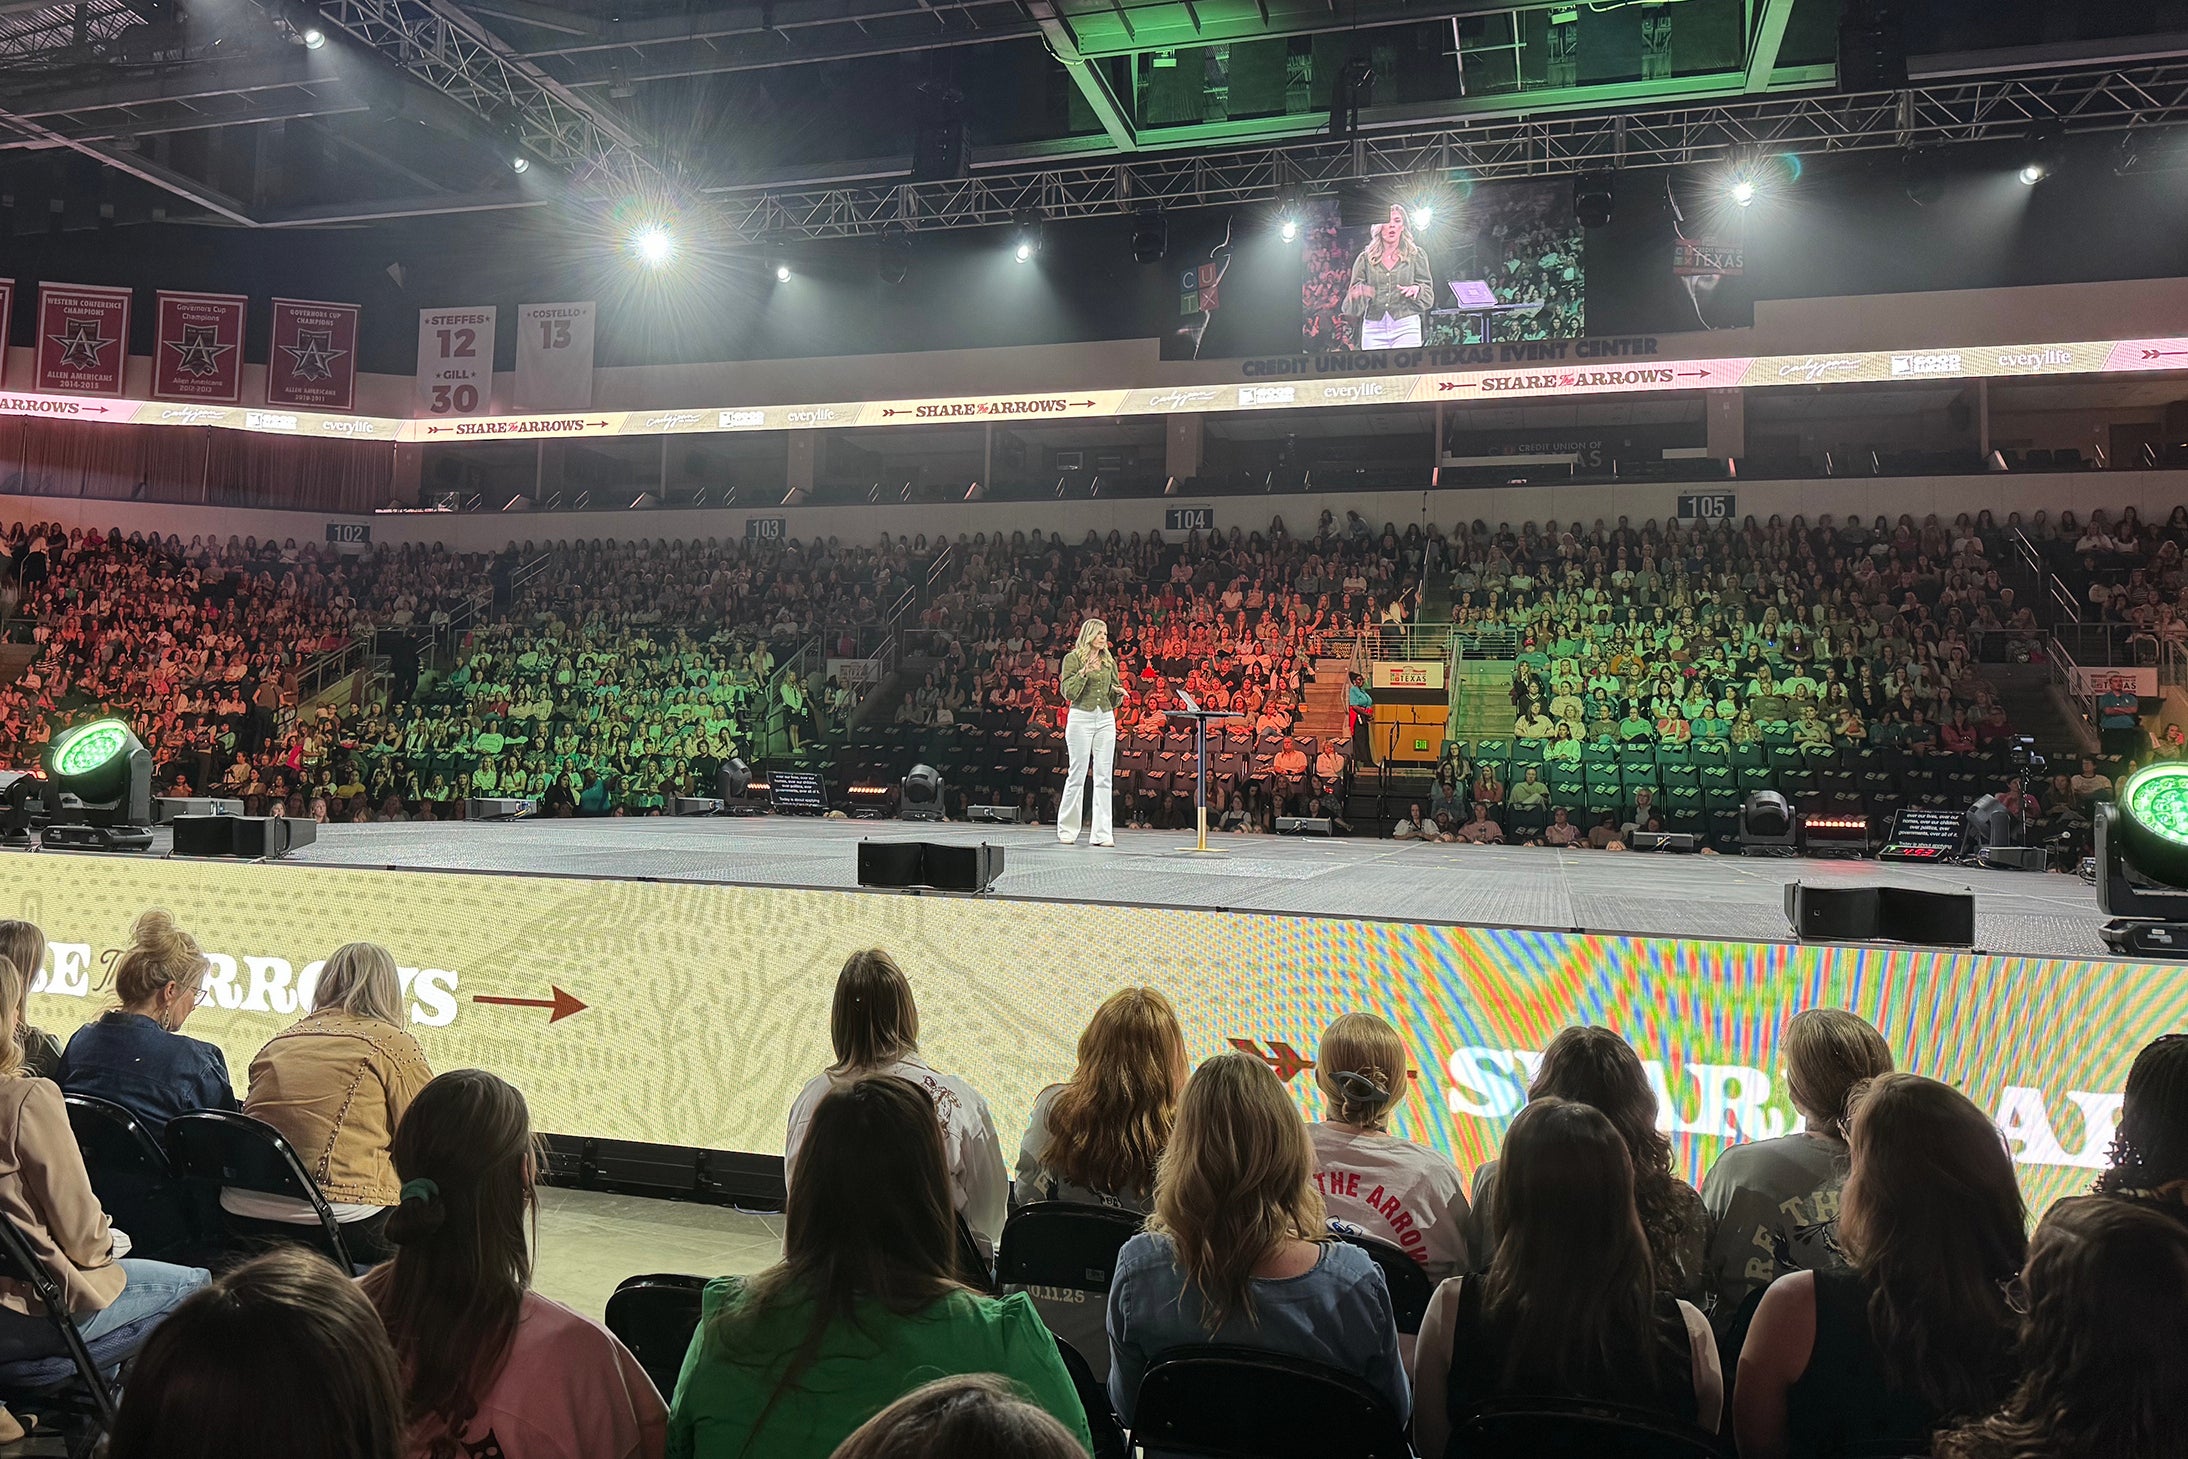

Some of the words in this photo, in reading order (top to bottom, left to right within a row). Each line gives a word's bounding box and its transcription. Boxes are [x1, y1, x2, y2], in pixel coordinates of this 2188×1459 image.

[1694, 253, 1744, 268] TEXAS
[47, 298, 78, 306] WESTERN
[80, 299, 122, 310] CONFERENCE
[63, 306, 104, 316] CHAMPIONS
[176, 304, 211, 312] Governors
[213, 305, 226, 314] Cup
[182, 312, 220, 322] Champions
[290, 309, 328, 318] GOVERNORS
[431, 314, 484, 325] STEFFES
[532, 308, 580, 319] COSTELLO
[296, 318, 334, 326] CHAMPIONS
[436, 328, 476, 358] 12
[540, 320, 572, 350] 13
[1241, 356, 1309, 376] CREDIT
[1316, 352, 1388, 374] UNION
[1394, 350, 1423, 368] OF
[1431, 346, 1495, 367] TEXAS
[1500, 342, 1568, 362] EVENT
[1575, 338, 1658, 358] CENTER
[1998, 349, 2073, 372] everylife
[47, 370, 69, 379] ALLEN
[70, 372, 113, 382] AMERICANS
[443, 370, 469, 380] GILL
[1481, 374, 1557, 391] SHARE
[1558, 373, 1574, 387] The
[1574, 368, 1674, 386] ARROWS
[60, 380, 100, 389] 2014-2015
[1323, 382, 1383, 401] everylife
[0, 398, 80, 414] ARROWS
[430, 384, 479, 414] 30
[787, 409, 835, 425] everylife
[916, 404, 975, 418] SHARE
[988, 400, 1066, 414] ARROWS
[322, 419, 374, 436] everylife
[456, 422, 507, 435] SHARE
[518, 420, 584, 433] ARROWS
[1518, 442, 1551, 452] CREDIT
[1552, 442, 1586, 451] UNION
[1688, 496, 1726, 518] 105
[1174, 510, 1206, 529] 104
[334, 526, 363, 542] 102
[752, 520, 779, 537] 103
[2104, 682, 2136, 690] TAS
[1778, 1190, 1840, 1227] TH
[1312, 1172, 1361, 1198] THE
[1365, 1184, 1429, 1268] ARROW
